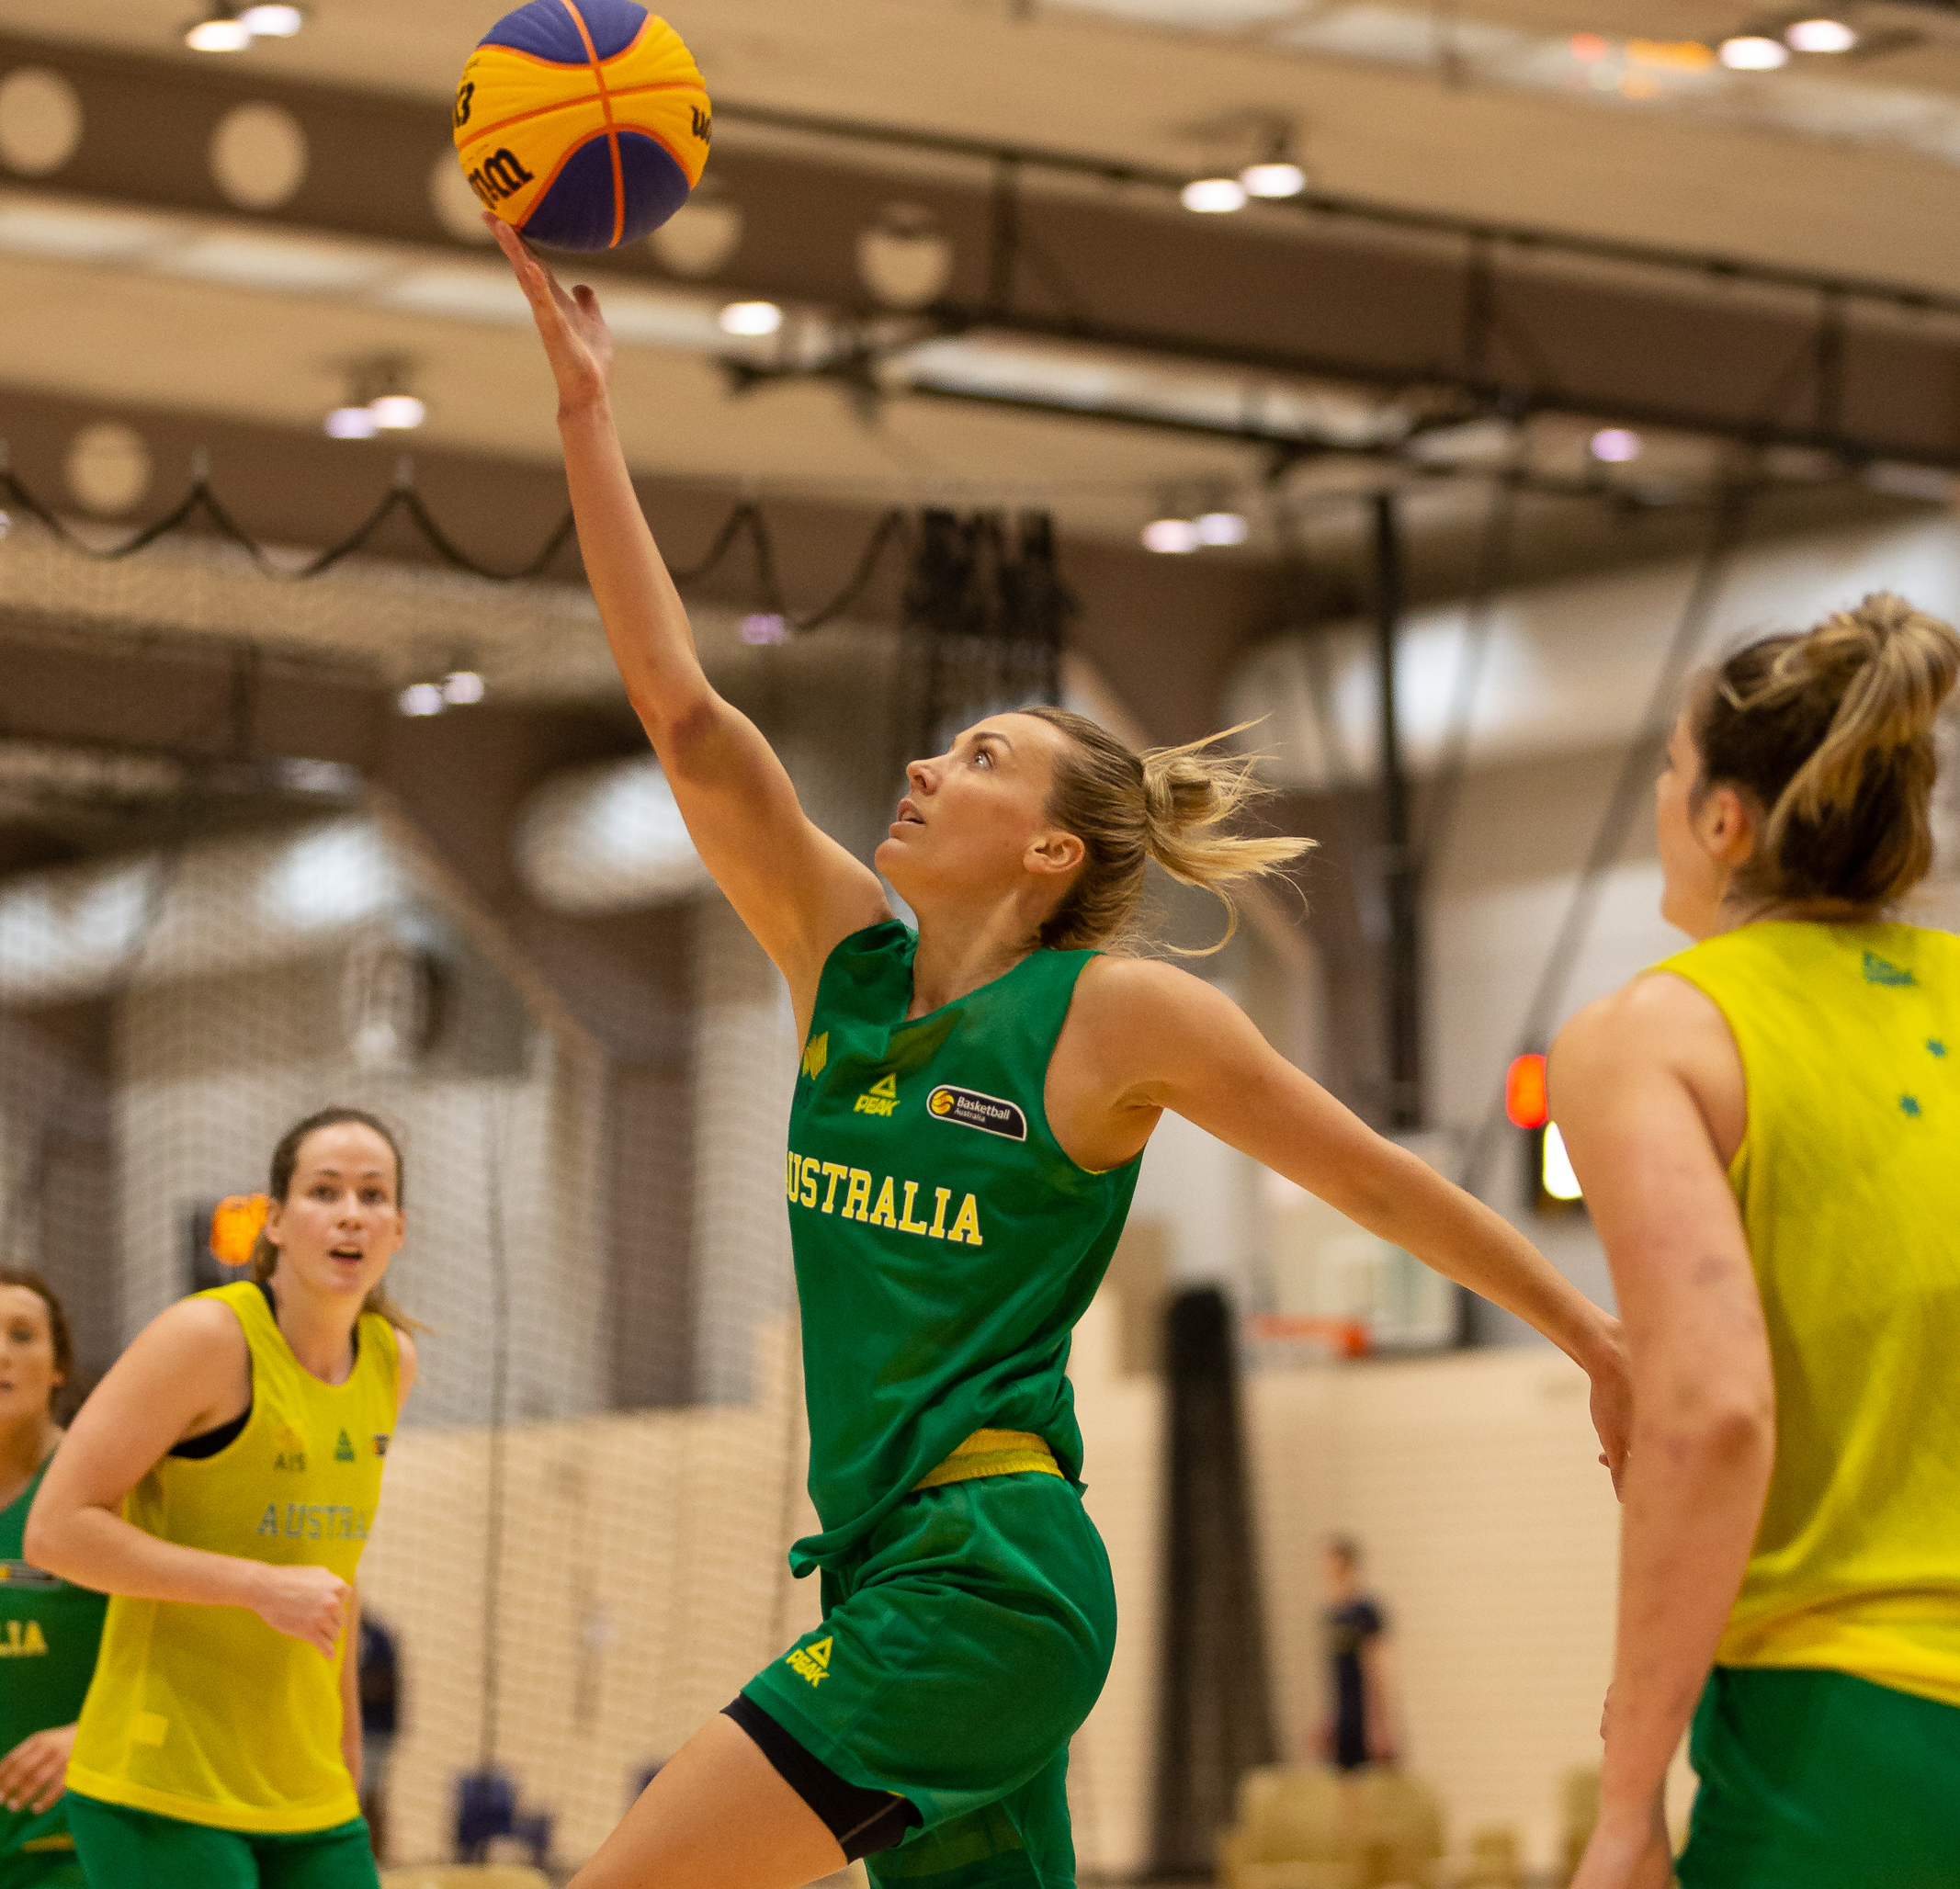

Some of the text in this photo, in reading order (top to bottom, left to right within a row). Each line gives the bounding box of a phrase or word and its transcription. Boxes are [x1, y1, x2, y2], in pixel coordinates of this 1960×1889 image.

[853, 1093, 901, 1117] PEAK
[954, 1108, 986, 1123] Australia
[957, 1096, 1011, 1121] Basketball
[786, 1150, 983, 1246] USTRALIA
[786, 1648, 830, 1688] PEAK
